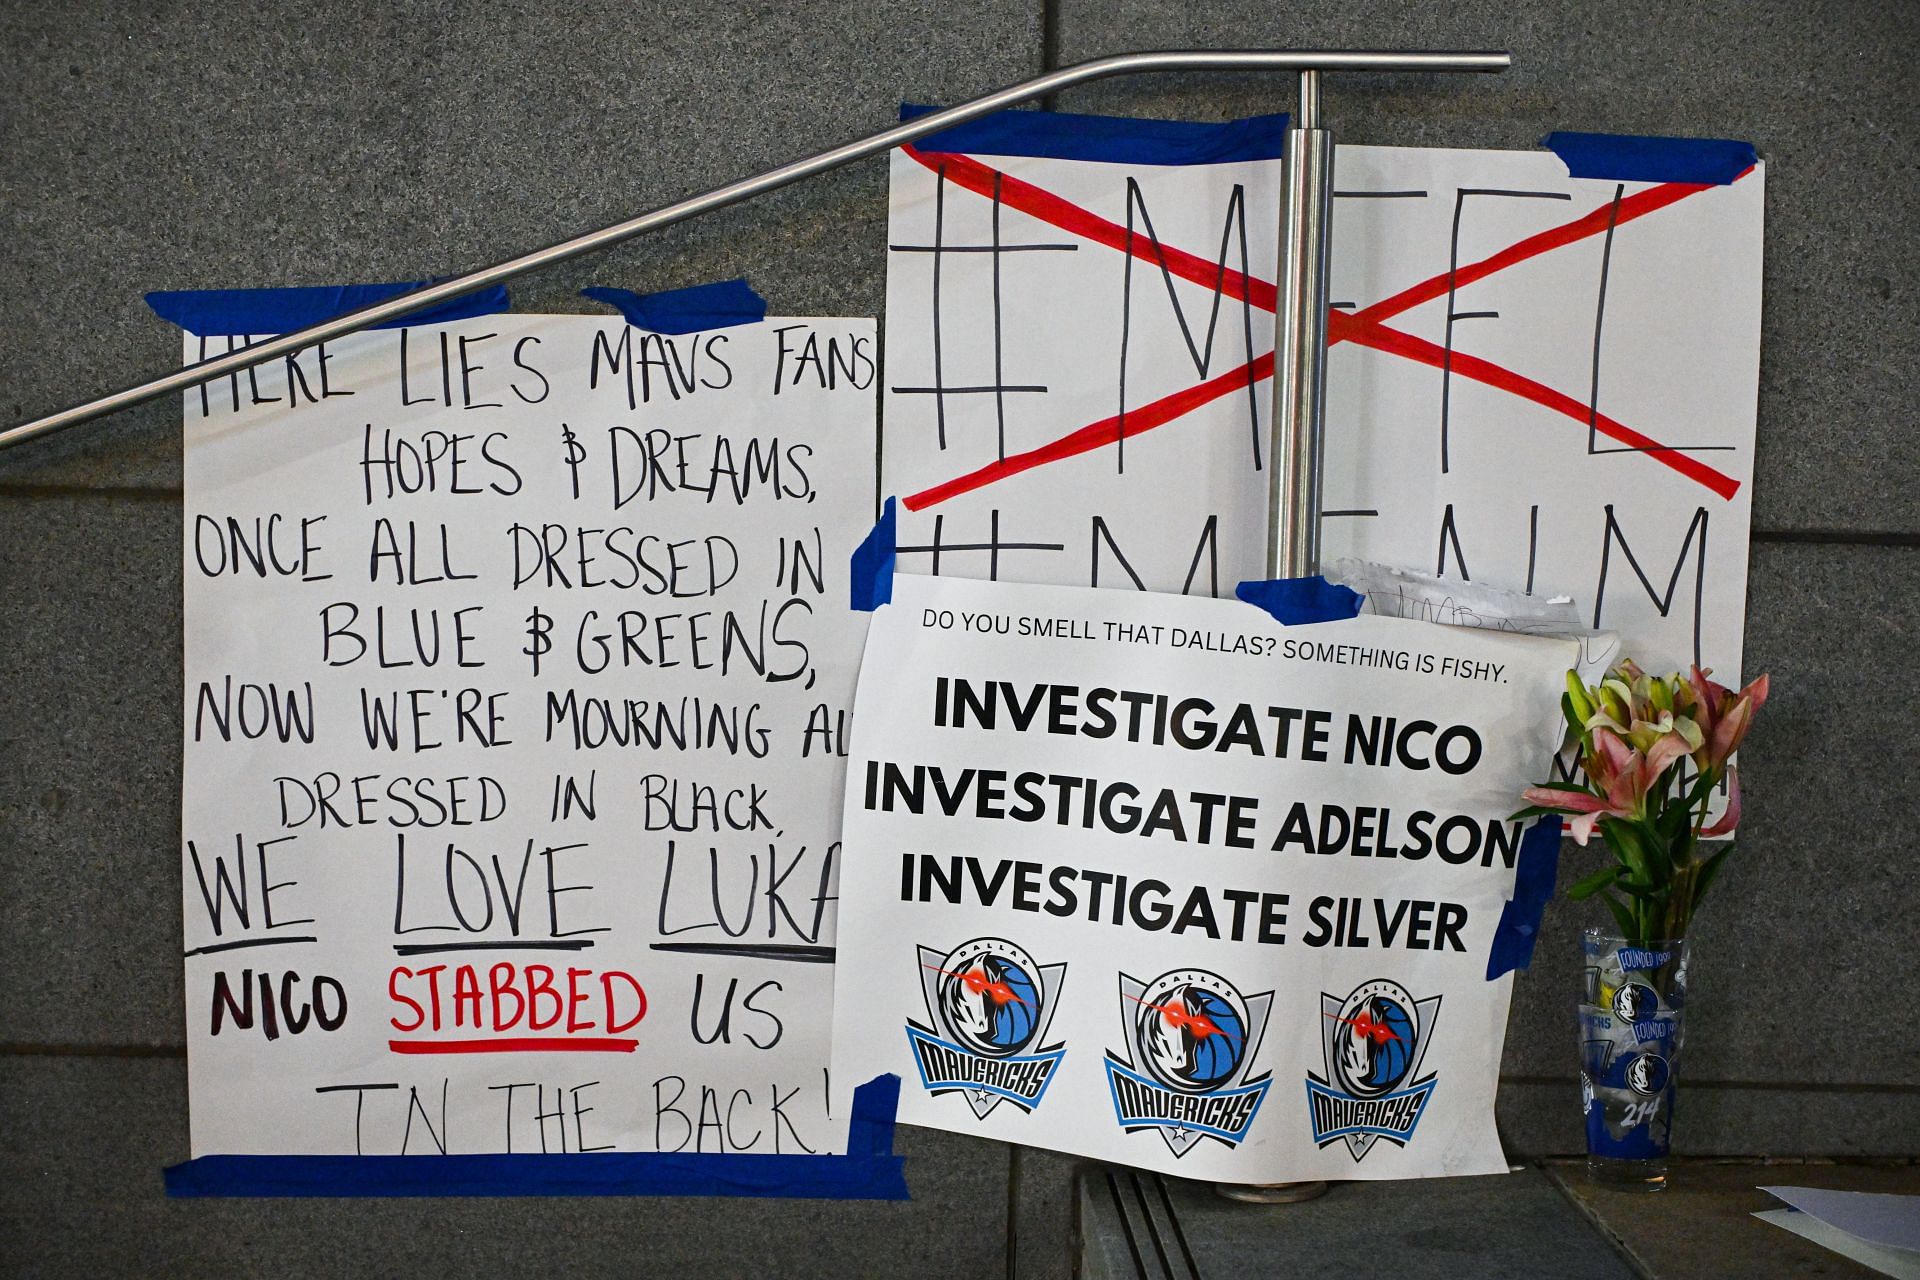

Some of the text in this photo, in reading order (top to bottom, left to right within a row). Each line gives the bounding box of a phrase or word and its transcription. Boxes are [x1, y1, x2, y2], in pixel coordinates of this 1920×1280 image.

[400, 328, 550, 409] LIES
[590, 325, 732, 410] MAVS
[773, 325, 875, 395] FANS
[359, 424, 523, 505] HOPES
[608, 427, 816, 510] DREAMS,
[195, 513, 333, 582] ONCE
[370, 517, 478, 585] ALL
[507, 523, 739, 597] DRESSED
[776, 527, 825, 595] IN
[320, 602, 485, 668] BLUE
[576, 598, 816, 689] GREENS,
[922, 608, 1508, 684] DO YOU SMELL THAT DALLAS? SOMETHING IS FISHY.
[195, 676, 314, 743] NOW
[361, 687, 513, 752] WE'RE
[545, 689, 771, 758] MOURNING
[934, 677, 1482, 775] INVESTIGATE NICO
[273, 770, 784, 838] DRESSED IN BLACK,
[864, 760, 1524, 869] INVESTIGATE ADELSON
[187, 833, 316, 937] WE
[394, 834, 612, 937] LOVE
[901, 853, 1468, 953] INVESTIGATE SILVER
[960, 943, 1028, 966] DALLAS
[1160, 974, 1232, 998] DALLAS
[1353, 984, 1407, 1004] DALLAS
[1620, 950, 1654, 969] FOUNDED
[210, 963, 783, 1049] NICO STABBED US
[1634, 1020, 1667, 1041] FOUNDED
[915, 1037, 1055, 1098] MAVERICKS
[1112, 1069, 1262, 1133] MAVERICKS
[488, 1082, 616, 1155] THE
[653, 1068, 833, 1156] BACK!
[1312, 1089, 1429, 1136] MAVERICKS
[1620, 1097, 1660, 1127] 214
